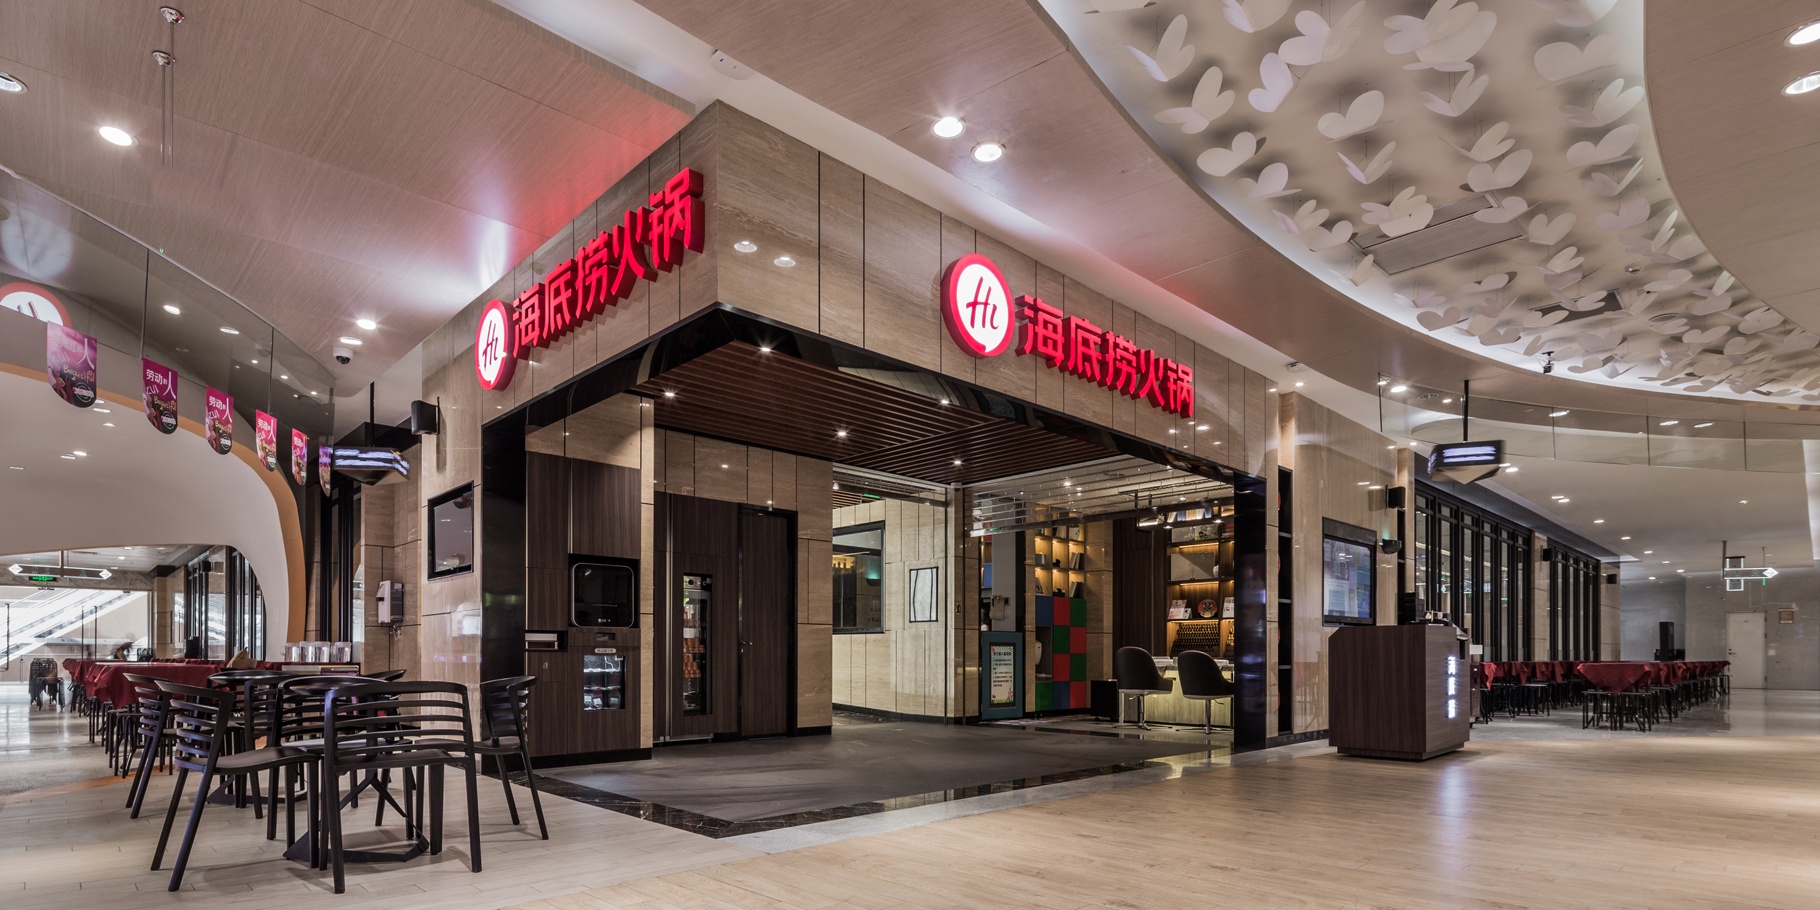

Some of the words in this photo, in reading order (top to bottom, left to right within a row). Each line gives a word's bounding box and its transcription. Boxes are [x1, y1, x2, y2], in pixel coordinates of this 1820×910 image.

[512, 167, 704, 360] 海底捞火锅
[1015, 295, 1194, 418] 海底捞火锅
